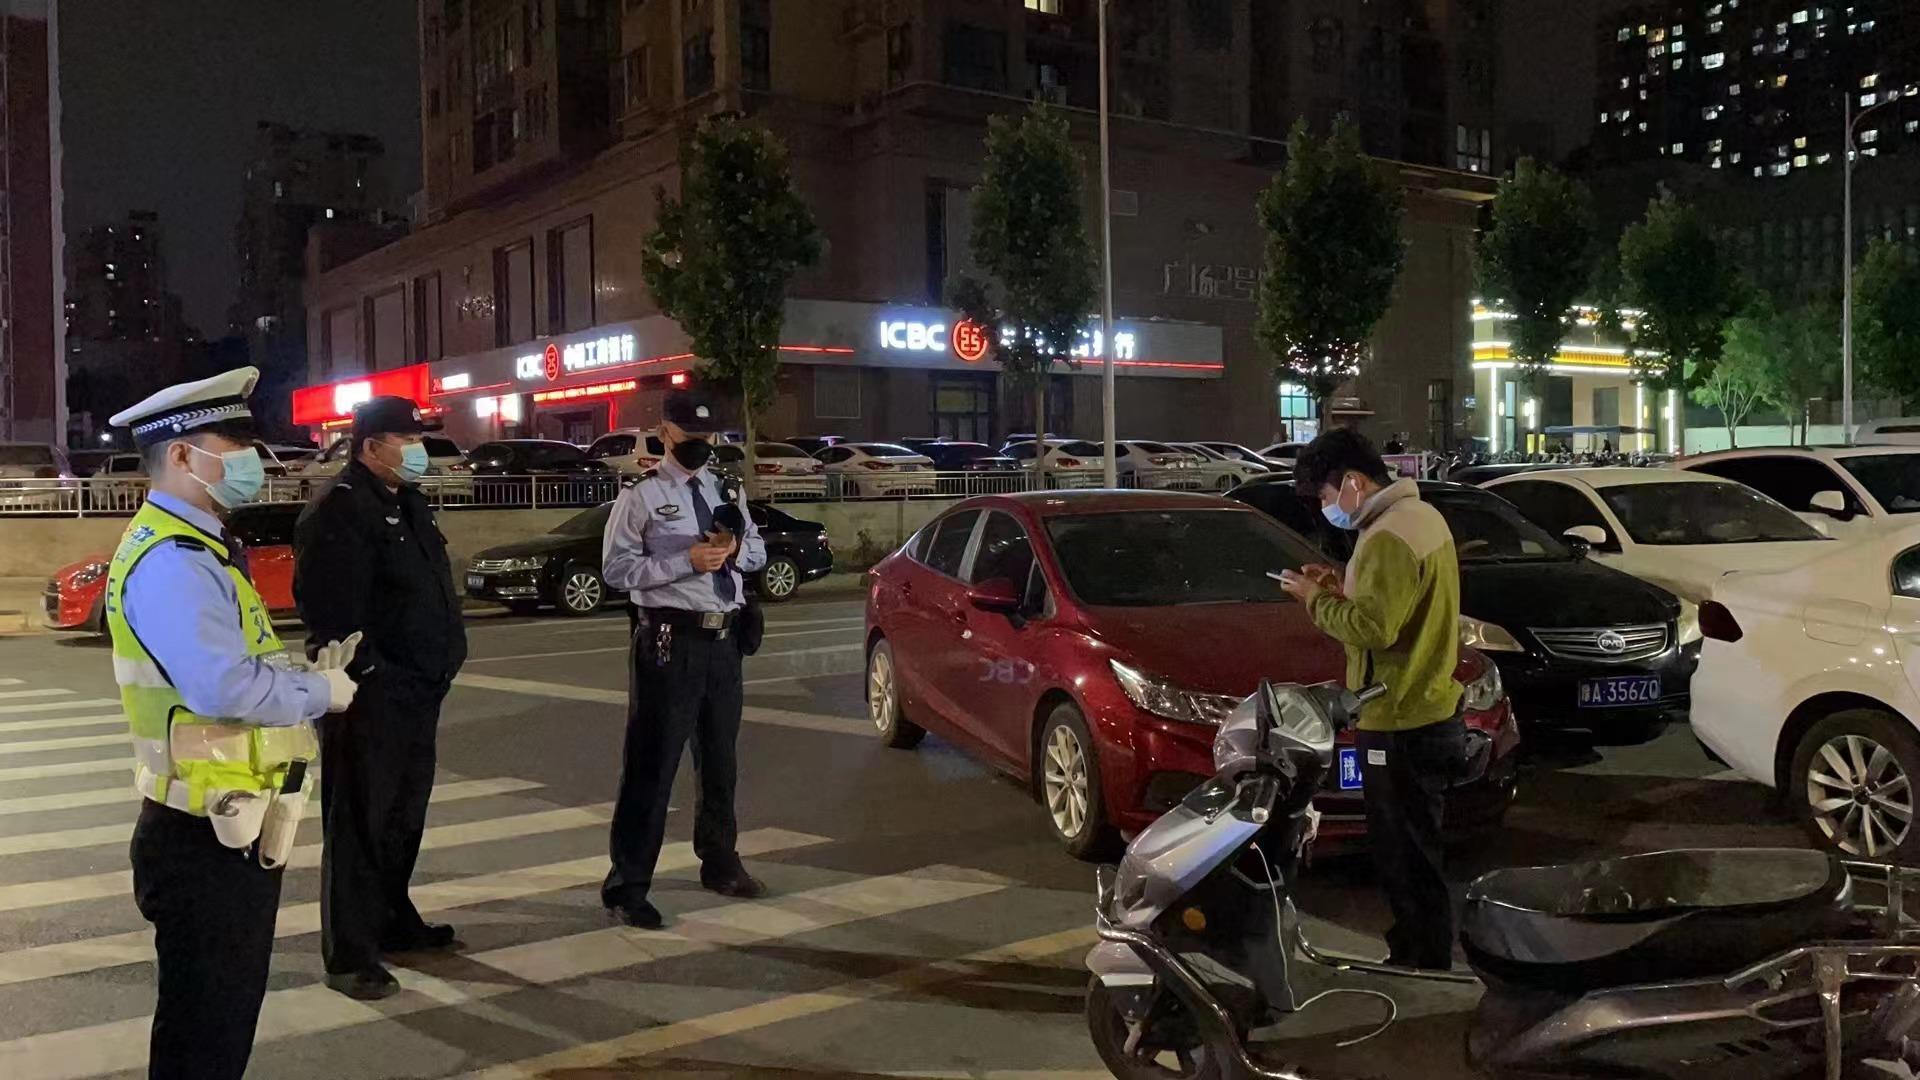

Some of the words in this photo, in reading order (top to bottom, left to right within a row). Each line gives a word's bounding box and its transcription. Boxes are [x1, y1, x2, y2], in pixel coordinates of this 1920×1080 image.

[880, 320, 945, 352] ICBC
[1601, 638, 1623, 648] BYD
[1343, 756, 1363, 782] 豫
